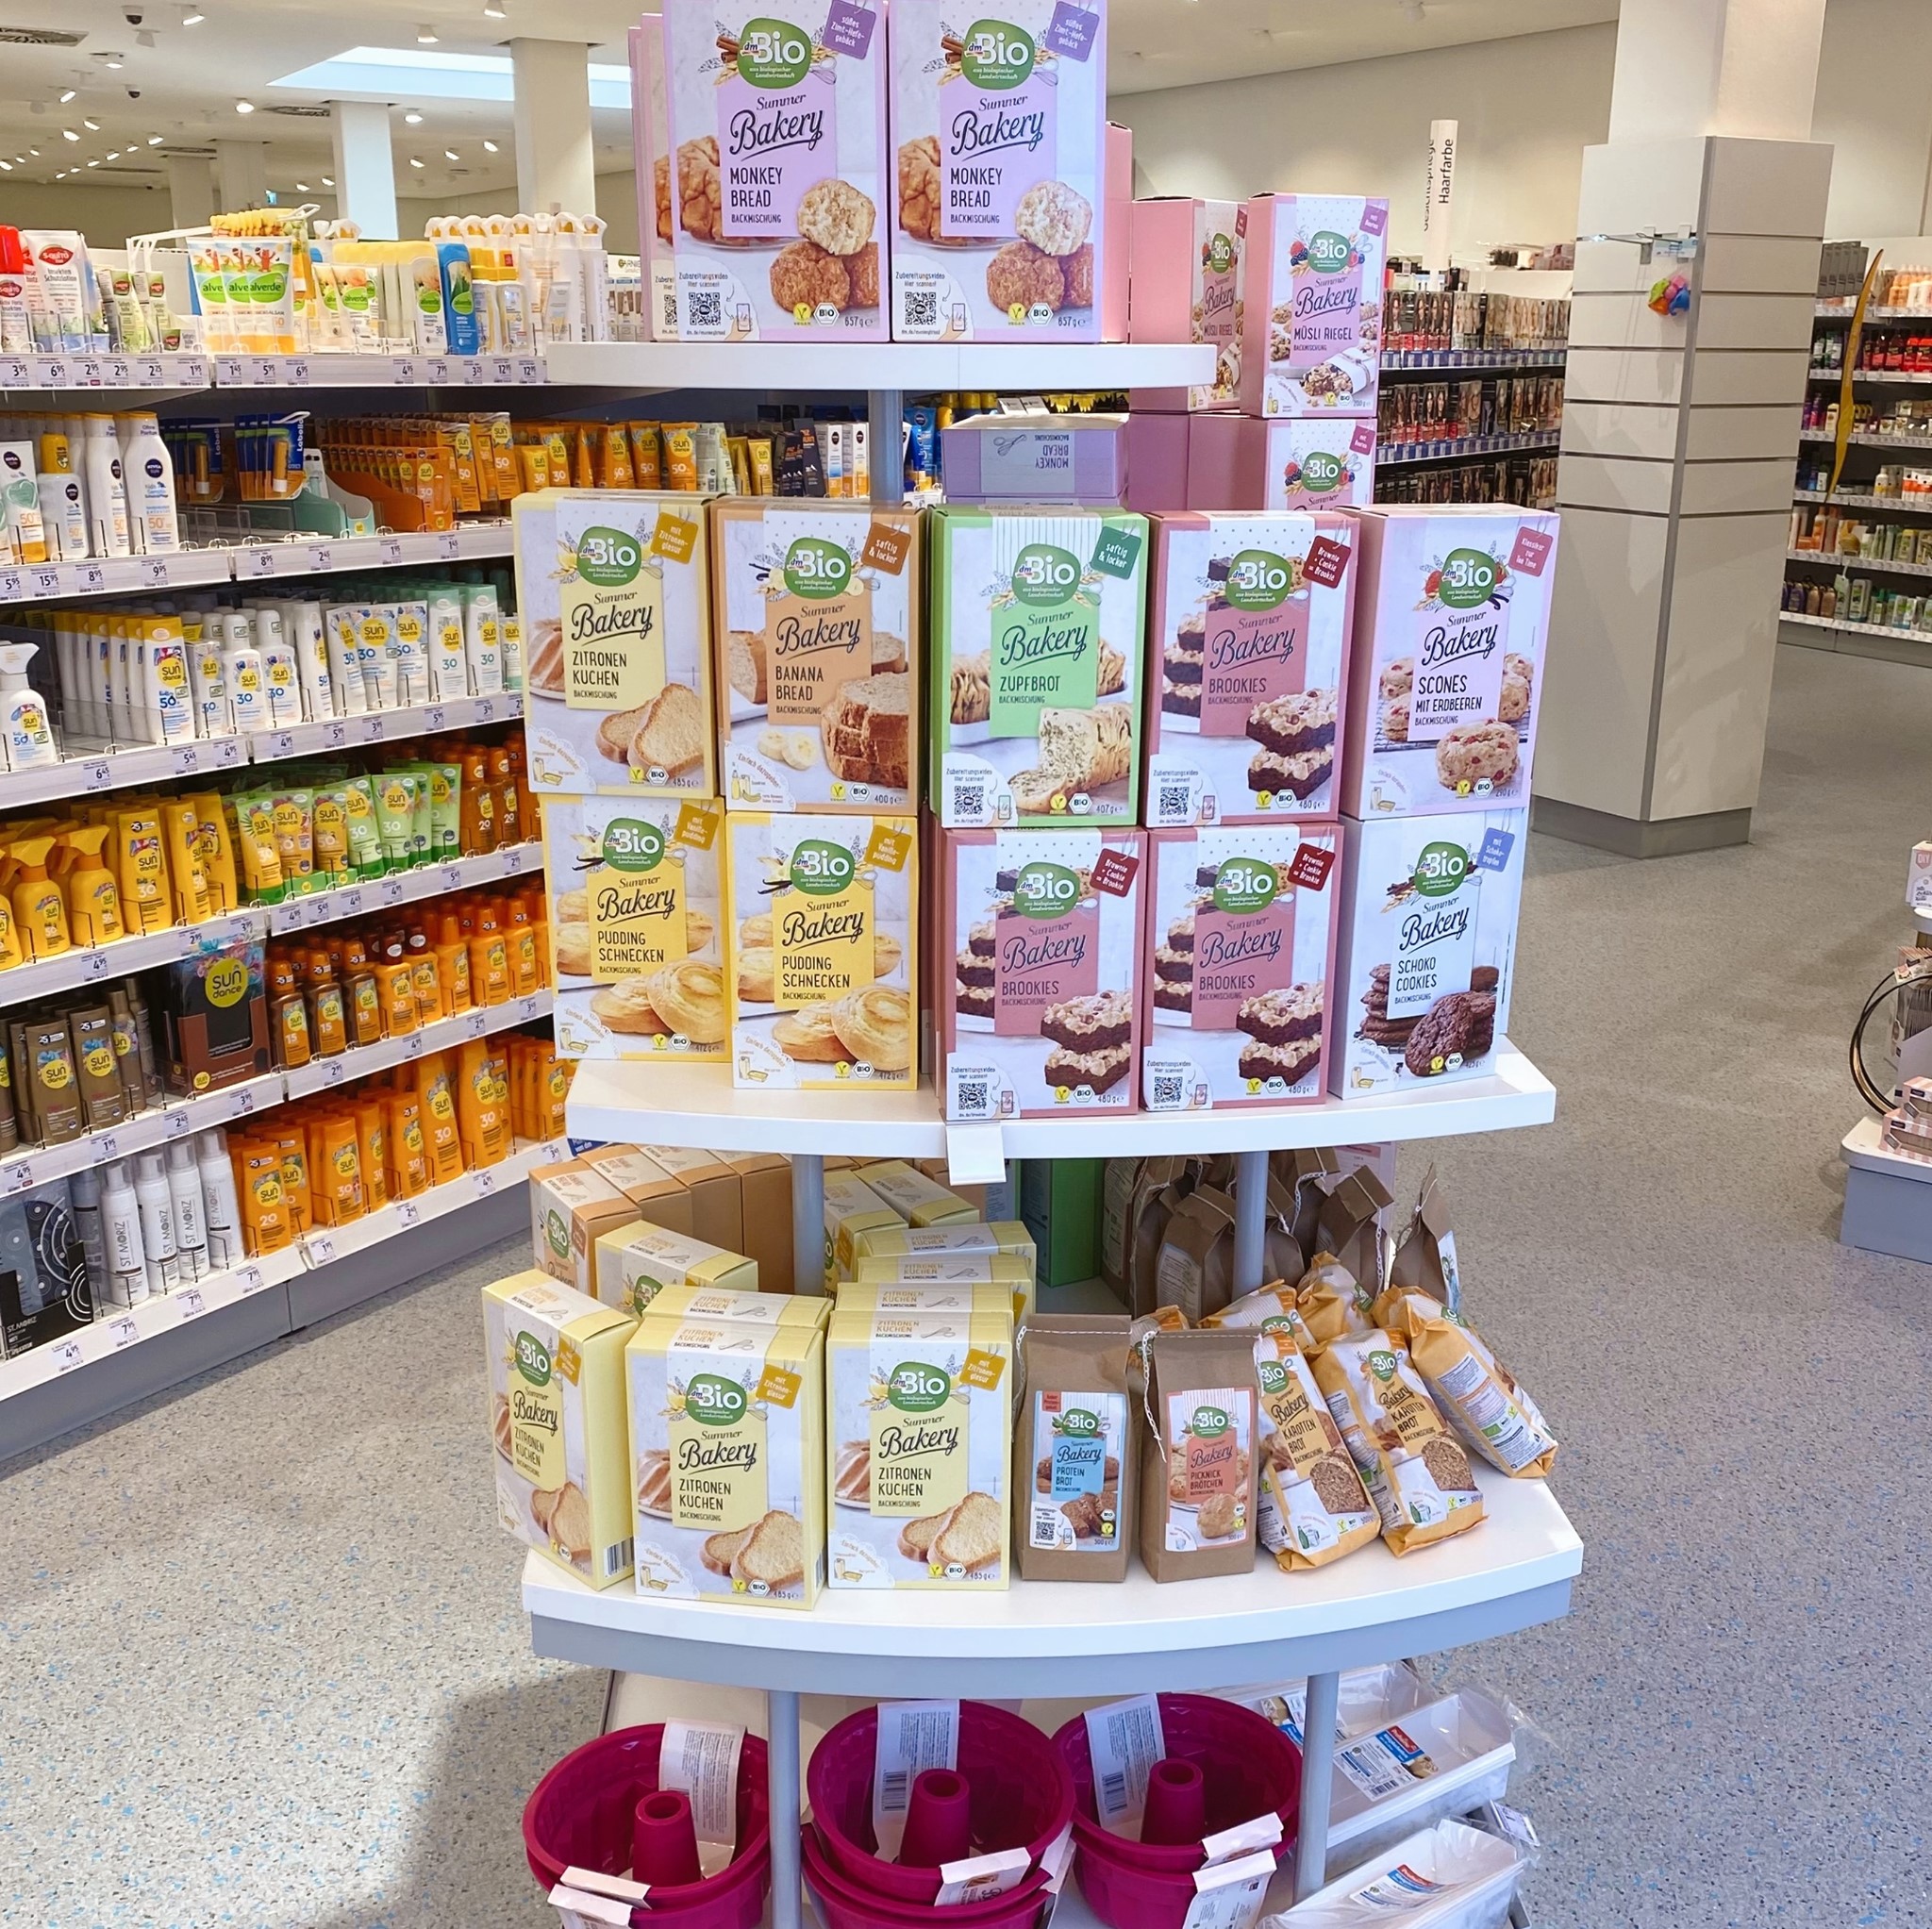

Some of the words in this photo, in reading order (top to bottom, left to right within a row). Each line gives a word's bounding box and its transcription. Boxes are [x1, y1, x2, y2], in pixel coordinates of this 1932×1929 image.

[750, 31, 806, 64] Bio
[974, 32, 1029, 65] Bio
[757, 93, 807, 110] Summer
[978, 94, 1028, 111] Summer
[729, 109, 823, 155] Bakery
[951, 109, 1043, 156] Bakery
[730, 167, 783, 185] MONKEY
[950, 168, 1002, 185] MONKEY
[1439, 140, 1453, 204] Haarfarbe
[731, 191, 771, 208] BREAD
[950, 191, 991, 208] BREAD
[731, 214, 781, 224] BACKMISCHUNG
[950, 214, 1000, 224] BACKMISCHUNG
[250, 282, 282, 291] alverde
[1295, 285, 1357, 318] Bakery
[1294, 325, 1321, 341] MÜSLI
[1324, 327, 1353, 341] RIEGEL
[493, 427, 508, 437] sun
[674, 439, 690, 448] sun
[1042, 445, 1069, 456] BREAD
[495, 457, 509, 468] 50
[1036, 457, 1069, 469] MONKEY
[534, 474, 545, 483] 30
[553, 471, 566, 482] 30
[671, 524, 682, 537] mit
[588, 537, 637, 566] Bio
[874, 538, 898, 554] saftig
[1106, 541, 1129, 558] saftig
[876, 548, 899, 565] locker
[1106, 552, 1127, 569] locker
[1317, 546, 1341, 563] Brownie
[798, 549, 846, 579] Bio
[1024, 555, 1074, 586] Bio
[1318, 557, 1337, 573] Cookie
[1240, 561, 1286, 590] Bio
[1314, 565, 1335, 581] Brookie
[1451, 559, 1492, 589] Bio
[594, 590, 638, 605] Summer
[800, 604, 845, 619] Summer
[1027, 611, 1074, 627] Summer
[1447, 612, 1487, 627] Summer
[364, 624, 384, 635] sun
[398, 622, 417, 632] sun
[572, 603, 653, 640] Bakery
[444, 631, 459, 641] sun
[775, 616, 860, 656] Bakery
[1000, 624, 1088, 665] Bakery
[1210, 628, 1295, 670] Bakery
[1422, 624, 1498, 666] Bakery
[358, 648, 375, 660] 30
[481, 654, 494, 665] 30
[573, 651, 627, 668] ZITRONEN
[162, 662, 181, 675] sun
[442, 658, 458, 670] 30
[241, 673, 257, 683] sun
[573, 670, 620, 686] KUCHEN
[775, 666, 824, 682] BANANA
[999, 674, 1061, 692] ZUPFBROT
[1209, 677, 1267, 693] BROOKIES
[1418, 675, 1468, 695] SCONES
[237, 693, 253, 705] 30
[574, 690, 617, 700] BACKMISCHUNG
[775, 685, 813, 701] BREAD
[1416, 699, 1430, 713] MIT
[1432, 696, 1482, 711] ERDBEEREN
[349, 825, 368, 839] 30
[382, 821, 402, 833] 30
[479, 820, 491, 831] 20
[613, 827, 659, 856] Bio
[139, 853, 158, 866] sun
[802, 850, 849, 878] Bio
[1426, 851, 1463, 879] Bio
[619, 876, 660, 889] Summer
[1026, 872, 1075, 901] Bio
[1225, 867, 1273, 895] Bio
[137, 883, 157, 897] 30
[596, 888, 675, 923] Bakery
[806, 899, 849, 912] Summer
[1423, 896, 1459, 914] Summer
[782, 911, 864, 947] Bakery
[1399, 906, 1469, 952] Bakery
[598, 930, 645, 945] PUDDING
[599, 948, 664, 962] SCHNECKEN
[1001, 934, 1086, 973] Bakery
[1199, 928, 1282, 969] Bakery
[782, 956, 832, 970] PUDDING
[1398, 956, 1437, 974] SCHOKO
[212, 967, 242, 988] sun
[783, 973, 851, 989] SCHNECKEN
[1199, 974, 1256, 989] BROOKIES
[1396, 973, 1438, 992] COOKIES
[1001, 980, 1059, 996] BROOKIES
[286, 1033, 298, 1043] 15
[208, 1187, 220, 1213] MORIZ
[181, 1200, 195, 1230] MORIZ
[258, 1213, 277, 1225] 20
[158, 1209, 174, 1241] MORIZ
[115, 1221, 130, 1252] MORIZ
[185, 1232, 196, 1244] ST
[162, 1241, 175, 1255] ST
[120, 1253, 132, 1268] ST
[899, 1371, 945, 1397] Bio
[696, 1382, 742, 1410] Bio
[1391, 1403, 1425, 1423] KAROTTEN
[1283, 1422, 1316, 1441] KAROTTEN
[878, 1426, 958, 1460] Bakery
[678, 1438, 757, 1472] Bakery
[878, 1467, 932, 1481] ZITRONEN
[1057, 1467, 1085, 1477] PROTEIN
[1191, 1470, 1221, 1480] PICKNICK
[679, 1478, 731, 1495] ZITRONEN
[1056, 1476, 1073, 1486] BROT
[1190, 1477, 1224, 1489] BRÖTCHEN
[878, 1483, 924, 1497] KUCHEN
[679, 1495, 724, 1511] KUCHEN
